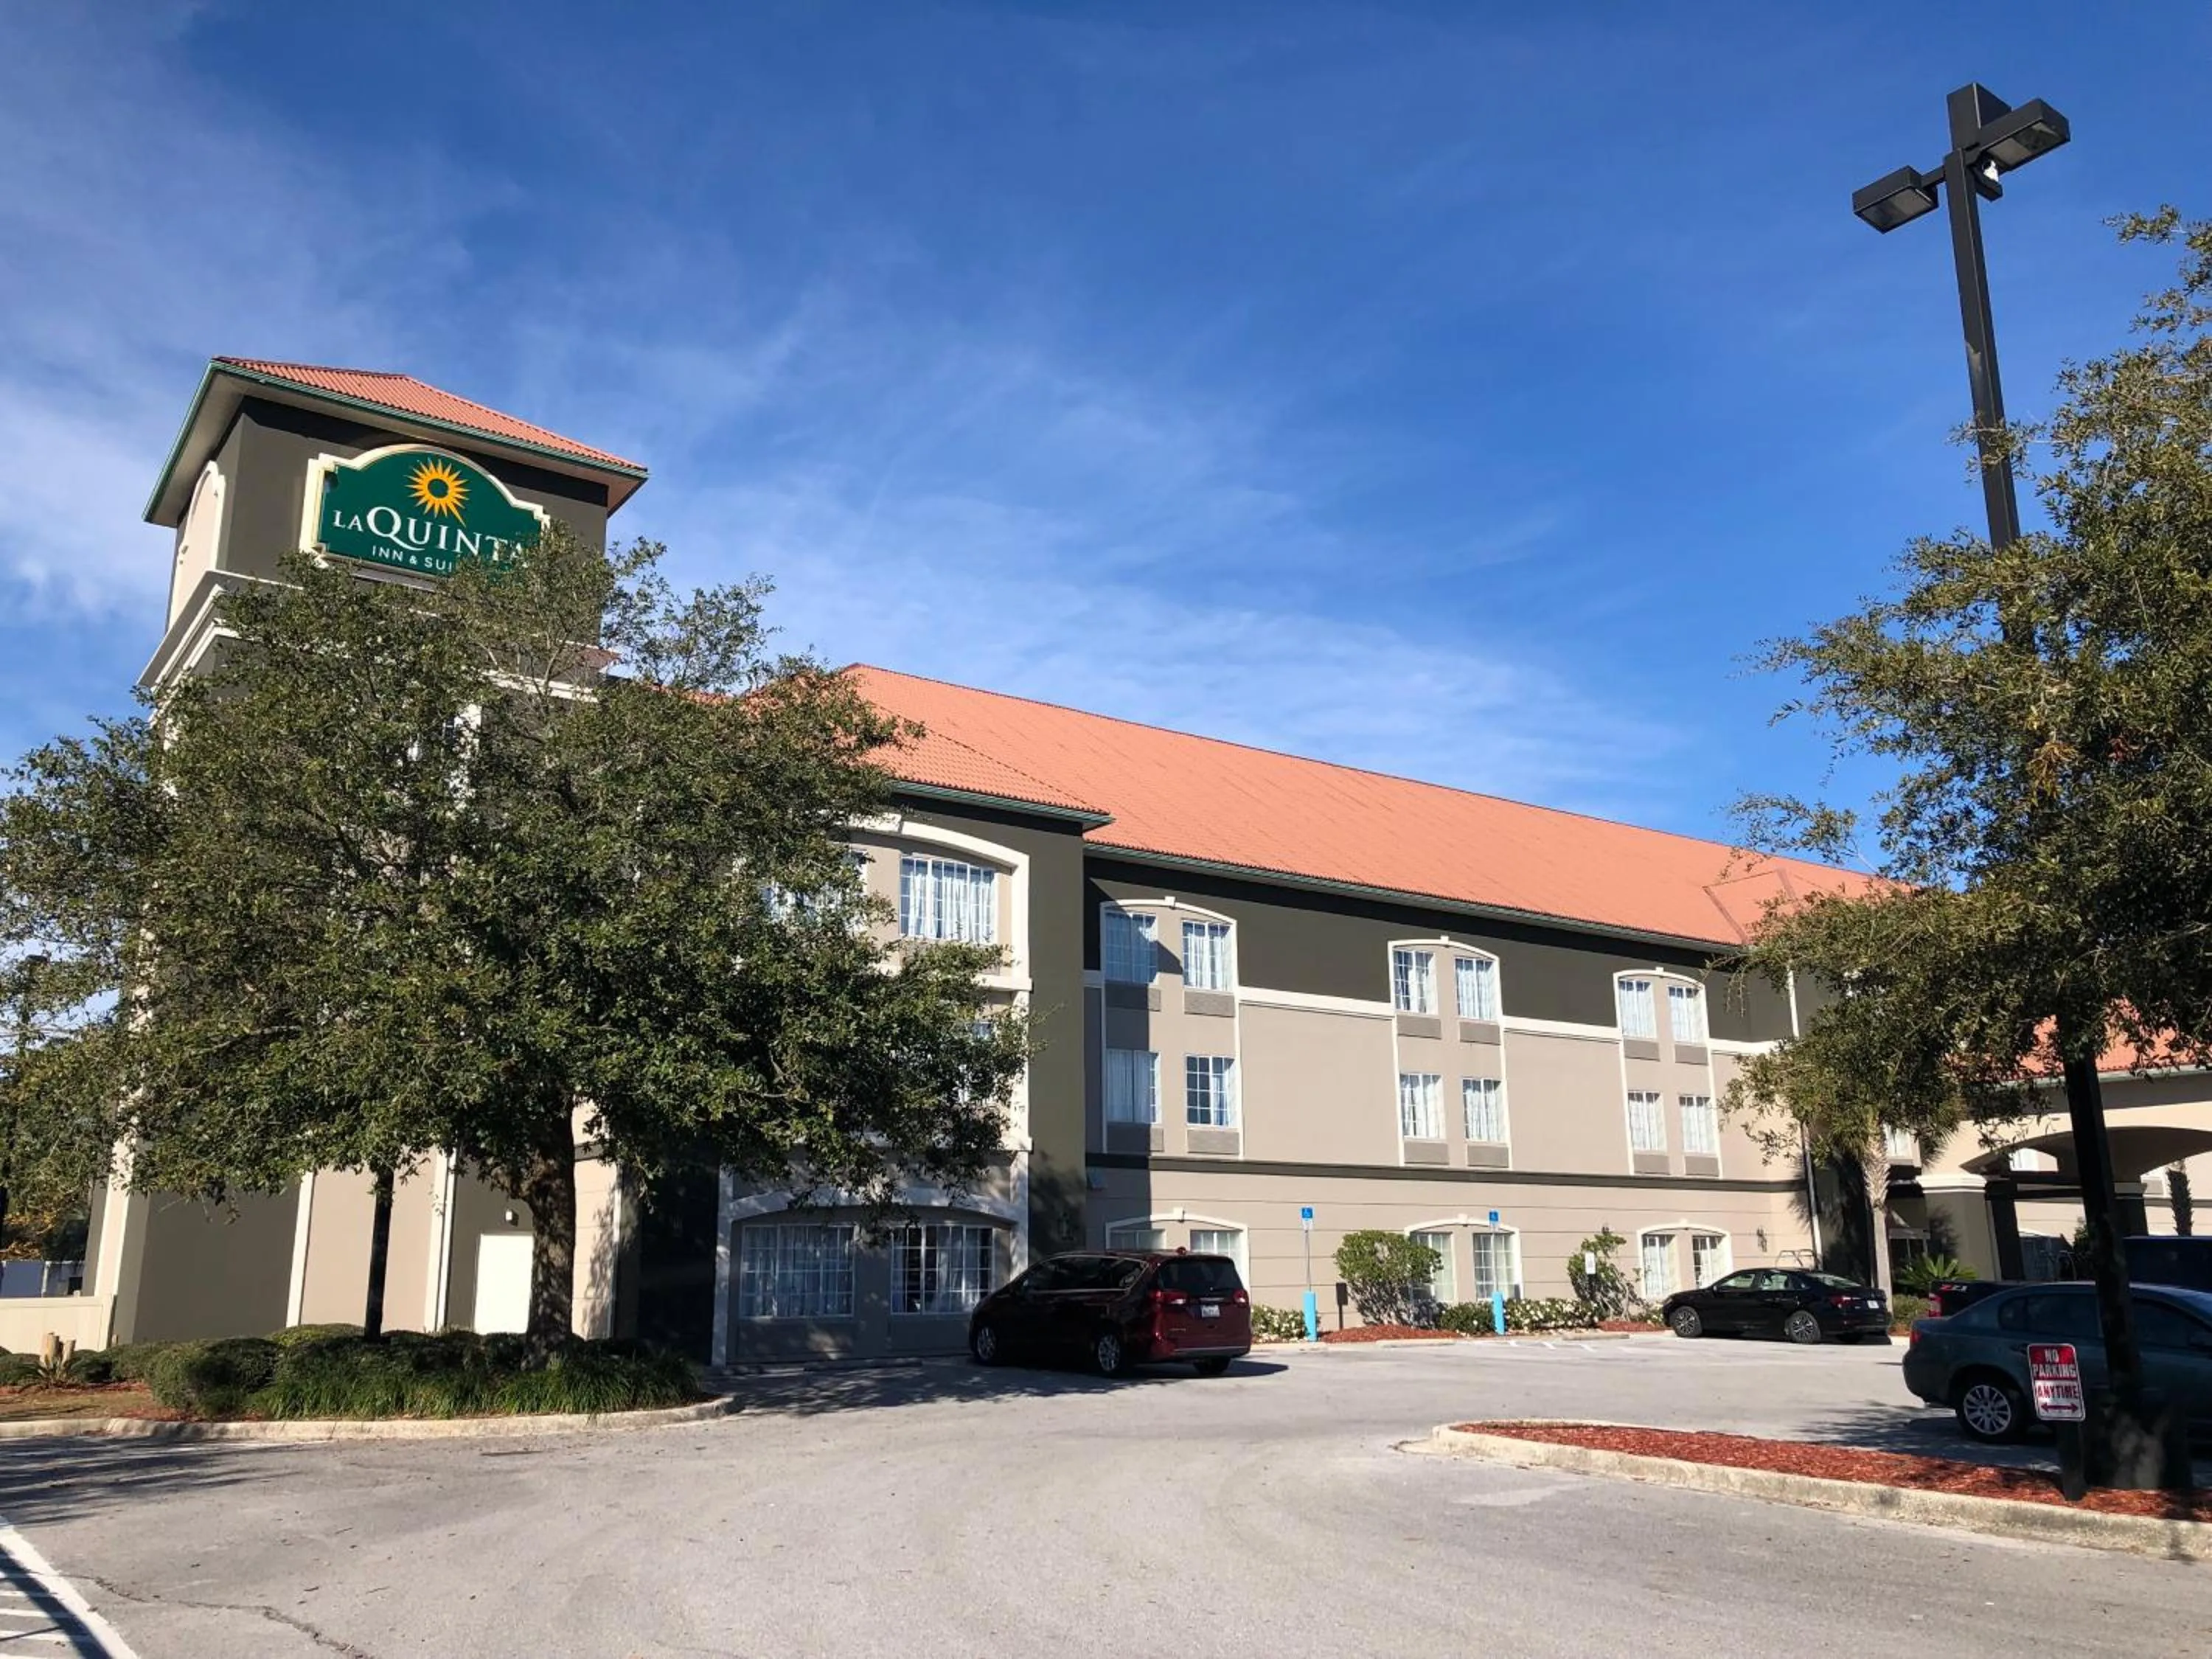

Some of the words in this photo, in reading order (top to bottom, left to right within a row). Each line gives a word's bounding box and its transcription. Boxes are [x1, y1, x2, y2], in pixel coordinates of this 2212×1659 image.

[333, 509, 364, 532] LA
[372, 545, 403, 563] INN
[409, 554, 418, 566] &
[423, 557, 453, 573] SUI
[2043, 1348, 2060, 1363] NO
[2032, 1363, 2078, 1379] PARKING
[2037, 1384, 2080, 1399] ANYTIME
